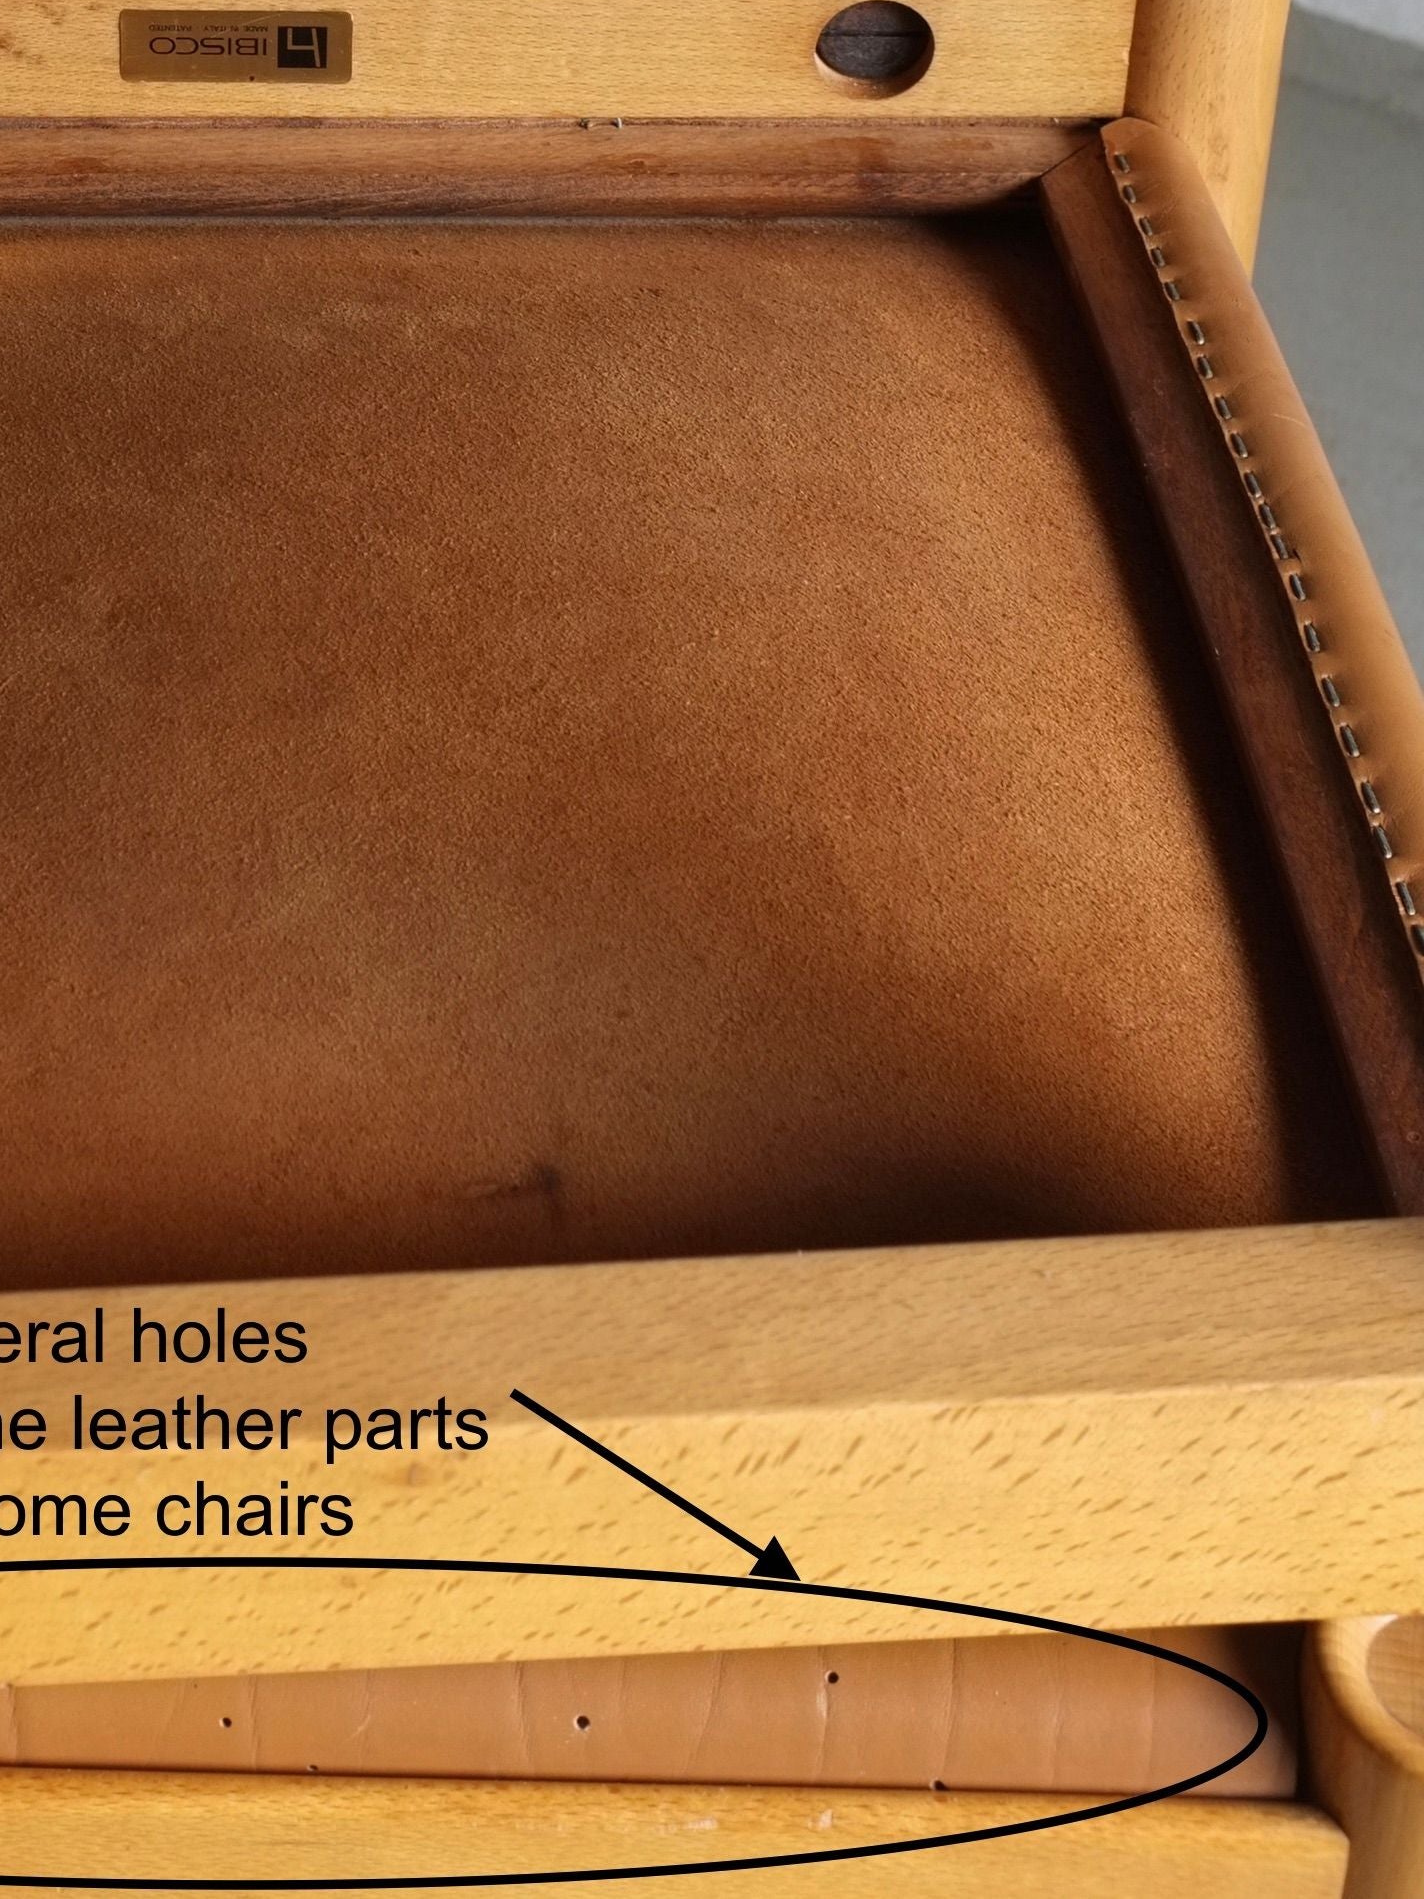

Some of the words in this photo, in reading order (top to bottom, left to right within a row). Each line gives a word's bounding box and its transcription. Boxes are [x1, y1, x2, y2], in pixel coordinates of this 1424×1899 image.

[148, 24, 192, 33] PATENTED
[203, 24, 227, 33] ITALY
[230, 24, 240, 33] IN
[244, 24, 268, 33] MADE
[149, 37, 268, 56] IBISCO
